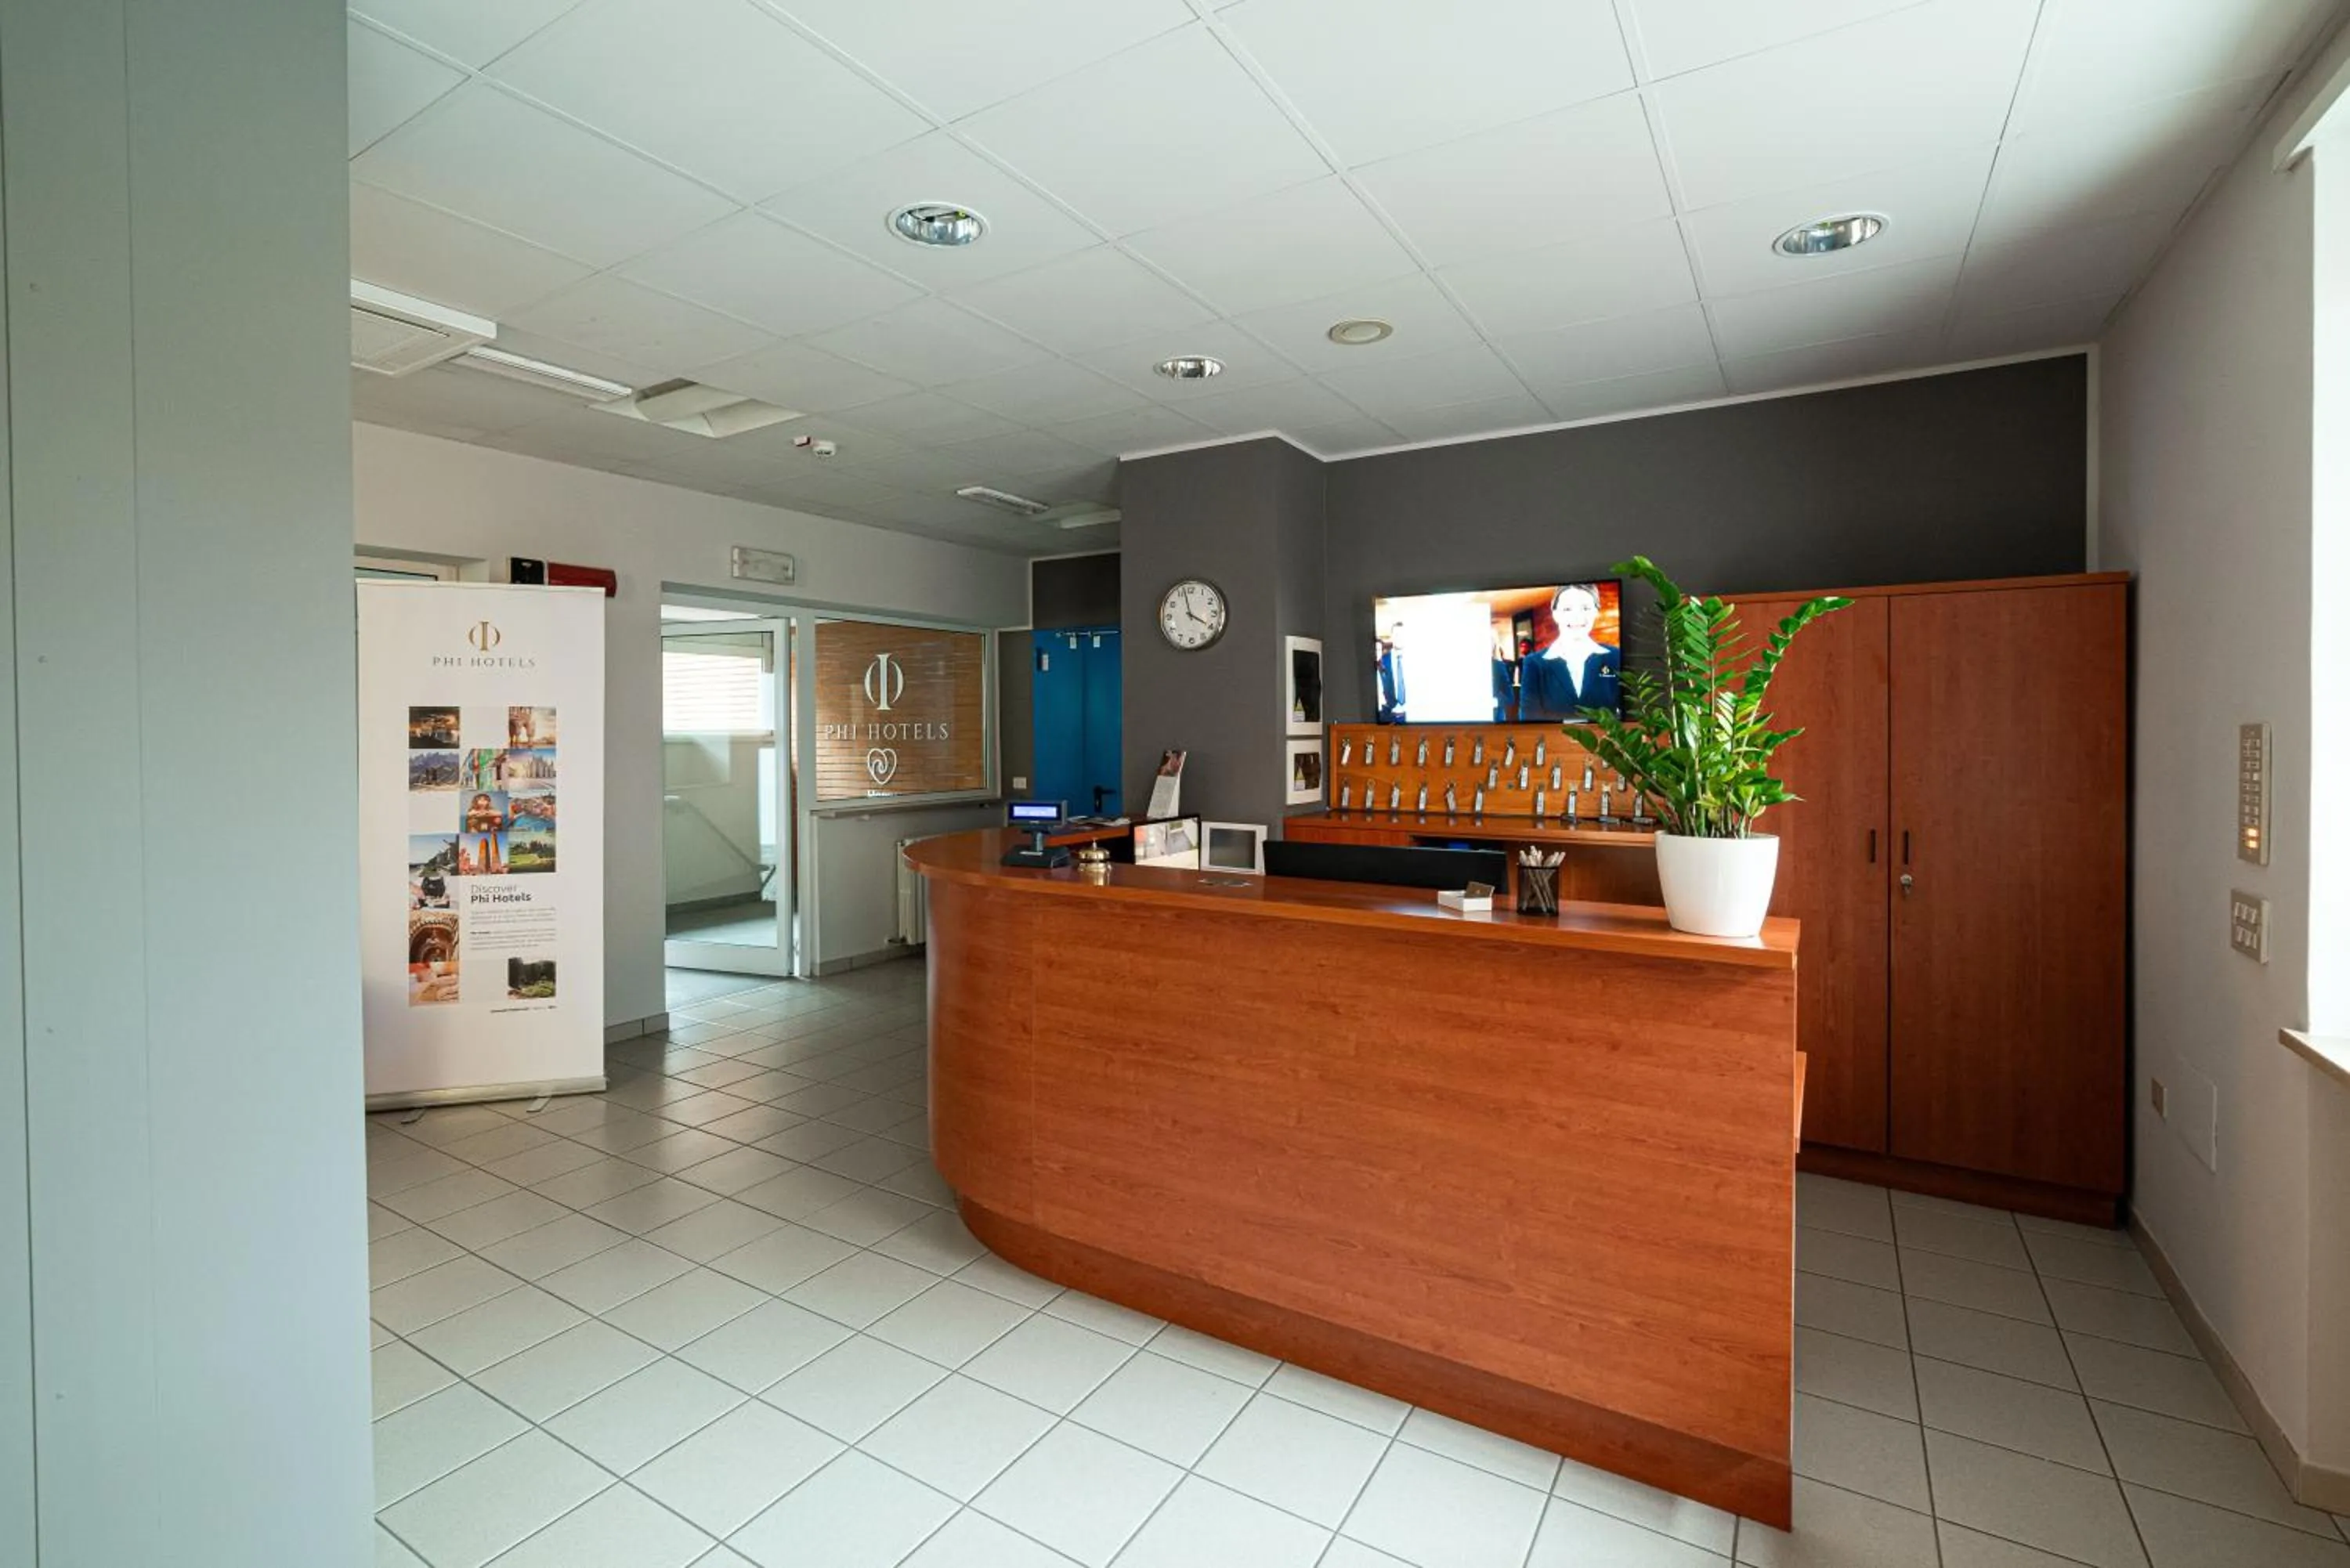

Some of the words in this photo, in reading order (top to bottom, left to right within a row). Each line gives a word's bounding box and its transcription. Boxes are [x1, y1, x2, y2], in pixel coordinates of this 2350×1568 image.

[432, 656, 462, 667] PHI
[470, 656, 537, 667] HOTELS
[825, 723, 857, 740] PHI
[869, 723, 949, 740] HOTELS
[471, 894, 490, 903] Phi
[493, 892, 533, 903] Hotels
